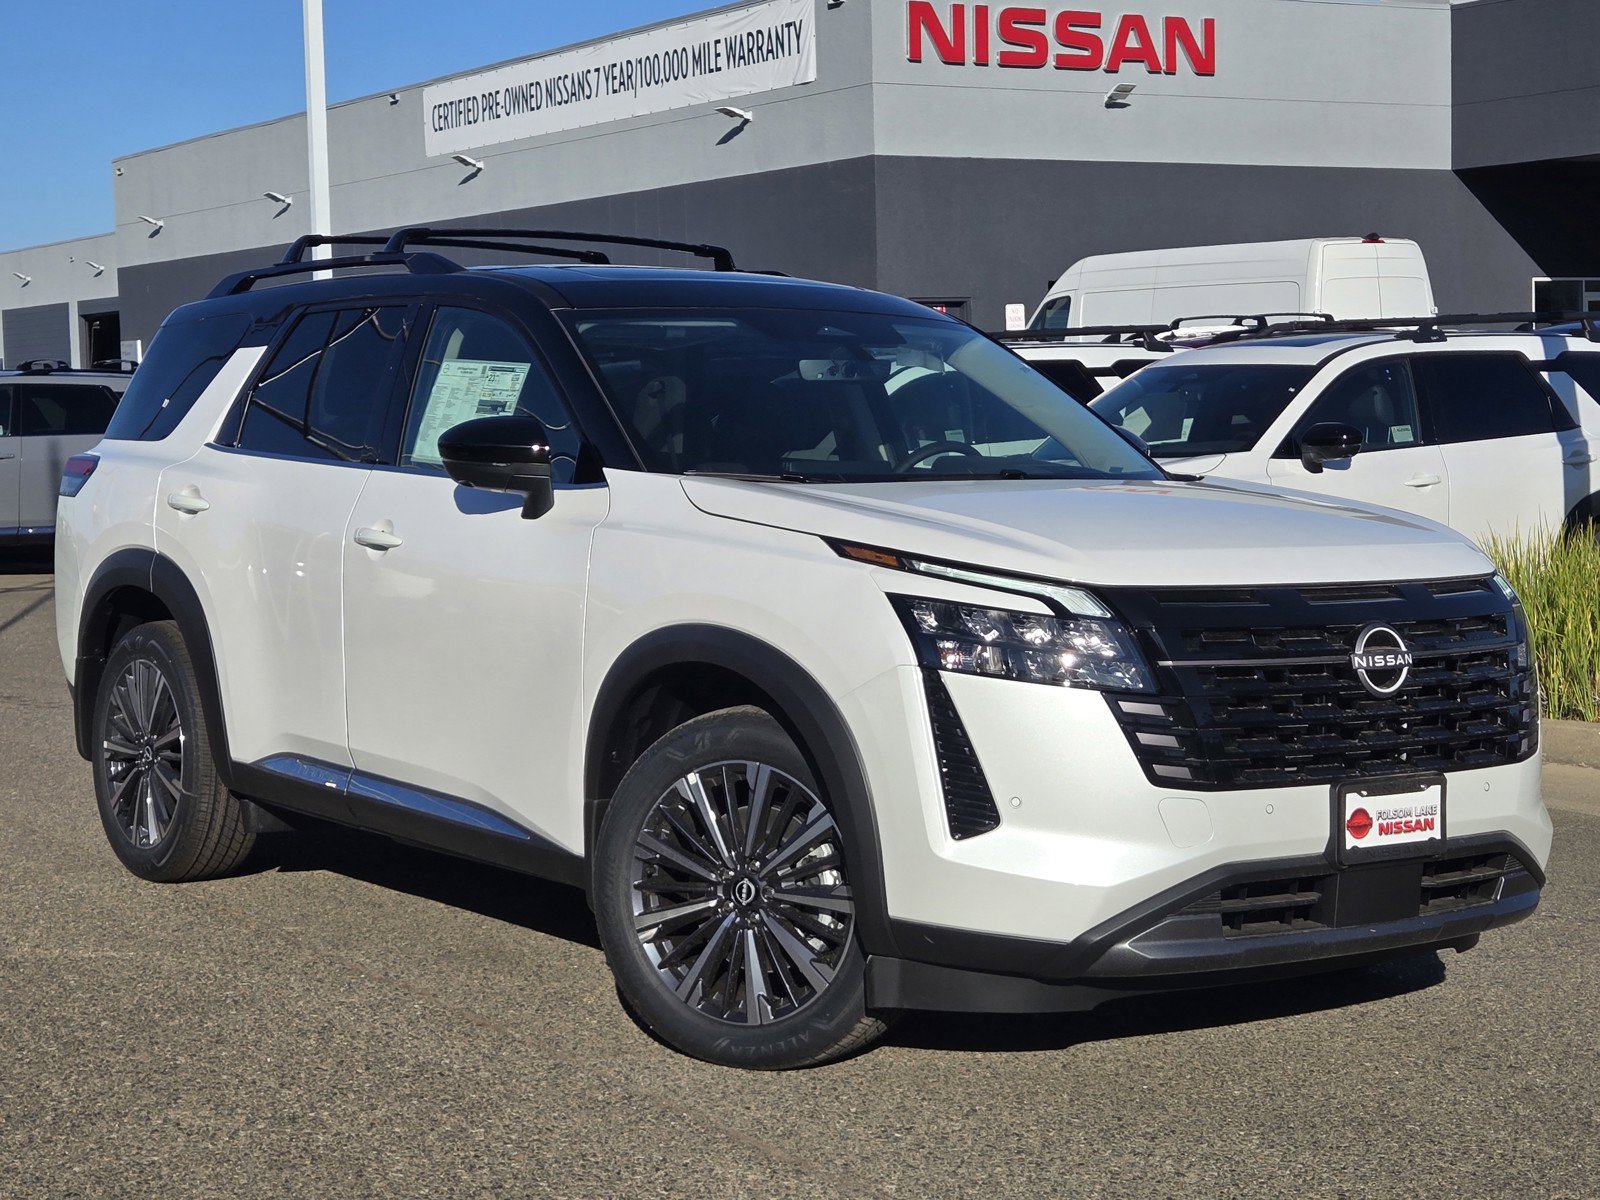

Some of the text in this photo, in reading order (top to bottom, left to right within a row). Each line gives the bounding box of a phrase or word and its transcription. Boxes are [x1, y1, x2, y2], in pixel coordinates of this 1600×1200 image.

[907, 0, 1215, 76] NISSAN
[432, 96, 479, 132] CERTIFIED
[481, 81, 542, 121] PRE-OWNED
[545, 68, 592, 108] NISSANS
[594, 67, 600, 97] 7
[692, 39, 722, 76] MILE
[725, 19, 803, 69] WARRANTY
[1354, 653, 1413, 668] NISSAN
[1376, 804, 1437, 821] FOLSOM LAKE
[1378, 817, 1435, 836] NISSAN
